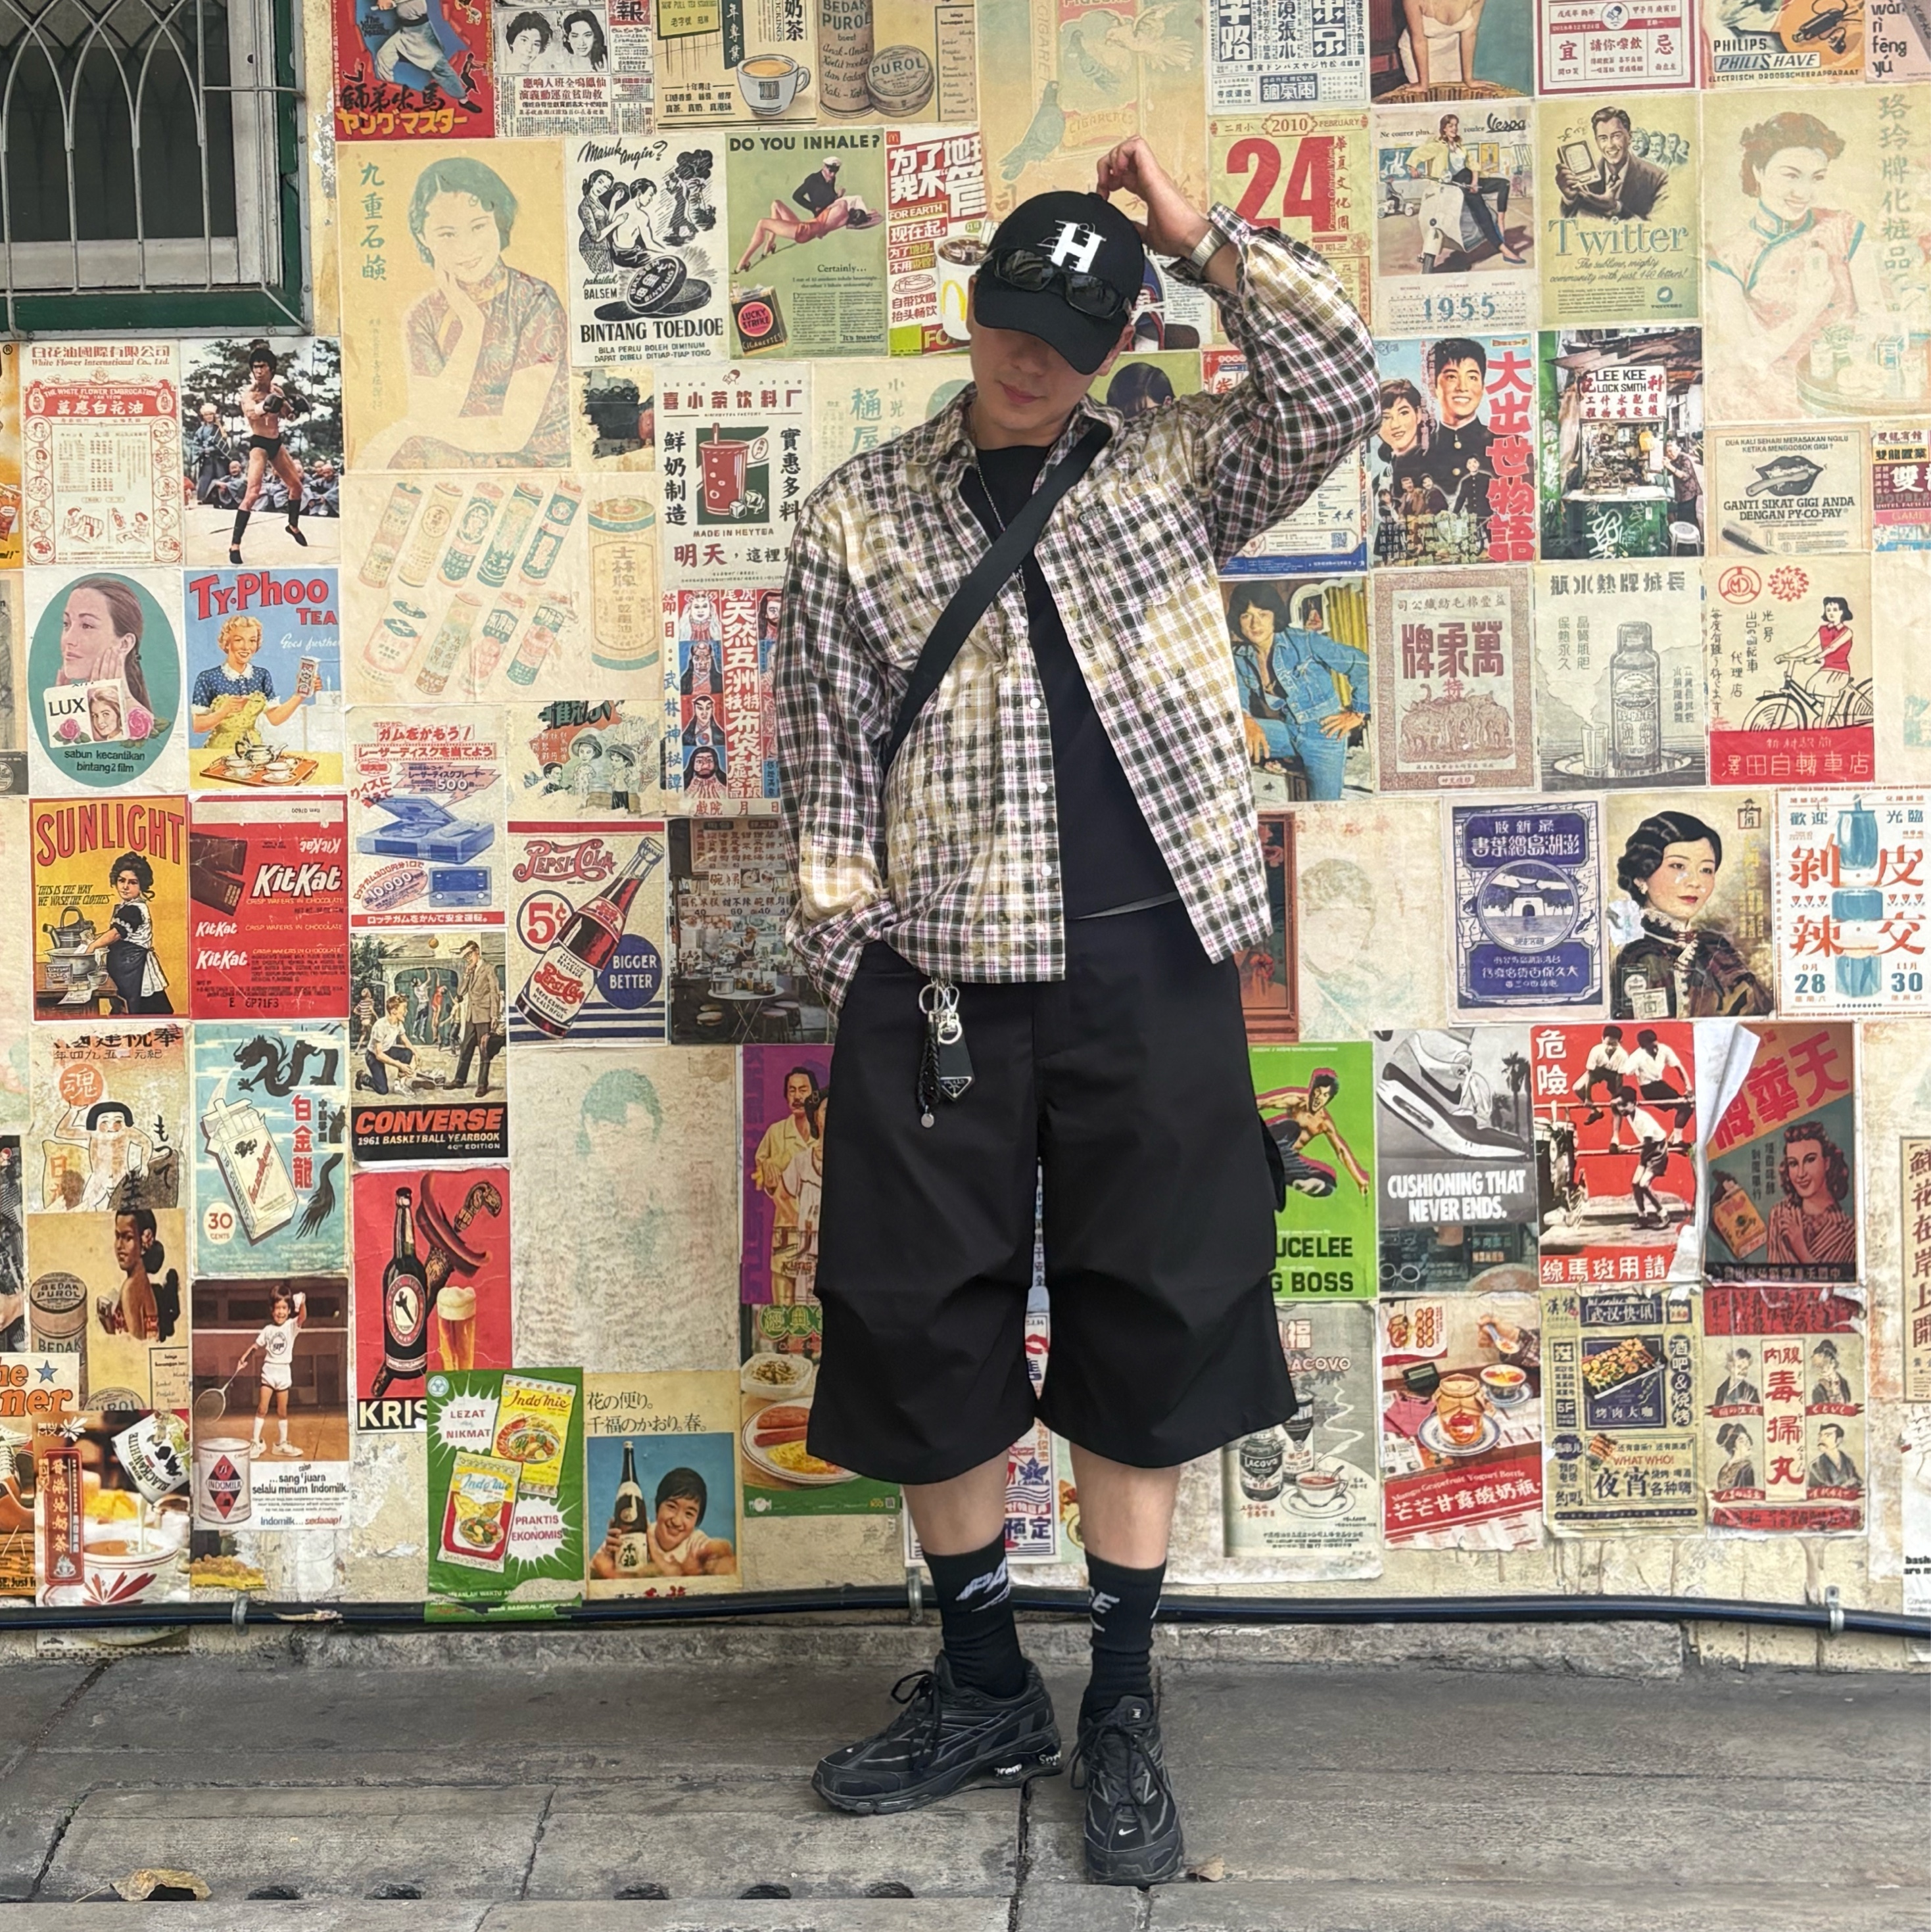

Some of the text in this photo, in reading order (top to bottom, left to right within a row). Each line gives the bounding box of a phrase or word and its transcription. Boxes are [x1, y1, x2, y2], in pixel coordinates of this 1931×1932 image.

[615, 0, 644, 22] 報
[822, 11, 870, 30] PUROL
[1560, 41, 1577, 60] 宜
[1655, 34, 1674, 55] 忌
[1714, 39, 1767, 52] PHILIPS
[872, 58, 926, 77] PUROL
[1272, 118, 1308, 131] 2010
[1320, 118, 1359, 127] FEBRUARY
[1487, 112, 1526, 133] Vespa
[730, 137, 795, 151] DO YOU
[1226, 136, 1336, 233] 24
[890, 204, 942, 221] FOR EARTH
[1548, 217, 1688, 256] Twitter
[1047, 220, 1107, 273] H
[1575, 256, 1659, 270] The mighty
[1550, 273, 1596, 284] community
[1599, 270, 1617, 279] with
[1617, 271, 1635, 281] just
[1639, 269, 1656, 279] 140
[584, 288, 617, 300] BALSEM
[742, 308, 766, 320] LUCKY
[1423, 295, 1496, 320] 1955
[581, 318, 723, 342] BINTANG TOEDJOE
[742, 318, 769, 329] STRIKE
[1596, 369, 1646, 381] LEE KEE
[44, 389, 57, 397] THE
[110, 388, 157, 396] EMBROCATION
[1598, 383, 1646, 392] LOCK SMITH
[1485, 350, 1536, 562] 大出世物語
[1724, 496, 1855, 511] GANTI SIKAT GIGI ANDA
[1740, 509, 1784, 521] DENGAN
[297, 609, 338, 625] TEA
[48, 697, 87, 717] LUX
[64, 749, 145, 761] sabun kecantikan
[117, 763, 134, 773] film
[37, 803, 184, 867] SUNLIGHT
[252, 862, 342, 897] KitKat
[195, 922, 238, 937] KitKat
[195, 951, 247, 969] KitKat
[613, 955, 656, 969] BIGGER
[609, 974, 652, 989] BETTER
[1795, 972, 1923, 995] 28 30
[64, 1068, 98, 1099] 魂
[356, 1108, 504, 1135] CONVERSE
[293, 1095, 313, 1189] 白金龍
[358, 1133, 500, 1146] 1961 BASKETBALL YEARBOOK
[1387, 1169, 1526, 1198] CUSHIONING THAT
[1408, 1196, 1507, 1222] NEVER ENDS.
[208, 1213, 233, 1229] 30
[1316, 1237, 1353, 1258] LEE
[1292, 1271, 1354, 1292] BOSS
[36, 1290, 80, 1299] PUROL
[39, 1338, 82, 1353] BEDAK
[586, 1391, 653, 1410] 花の便り。
[1557, 1402, 1574, 1413] 5F
[450, 1409, 486, 1419] LEZAT
[446, 1429, 491, 1439] NIKMAT
[1613, 1455, 1674, 1465] WHAT WHO!
[208, 1480, 242, 1490] INDOMILK
[303, 1473, 325, 1484] juara
[1421, 1476, 1465, 1490] Grapefruit
[1467, 1473, 1498, 1482] Yogurt
[252, 1484, 349, 1494] selalu minum Indomilk.
[515, 1515, 559, 1526] PRAKTIS
[512, 1530, 563, 1542] EKONOMIS
